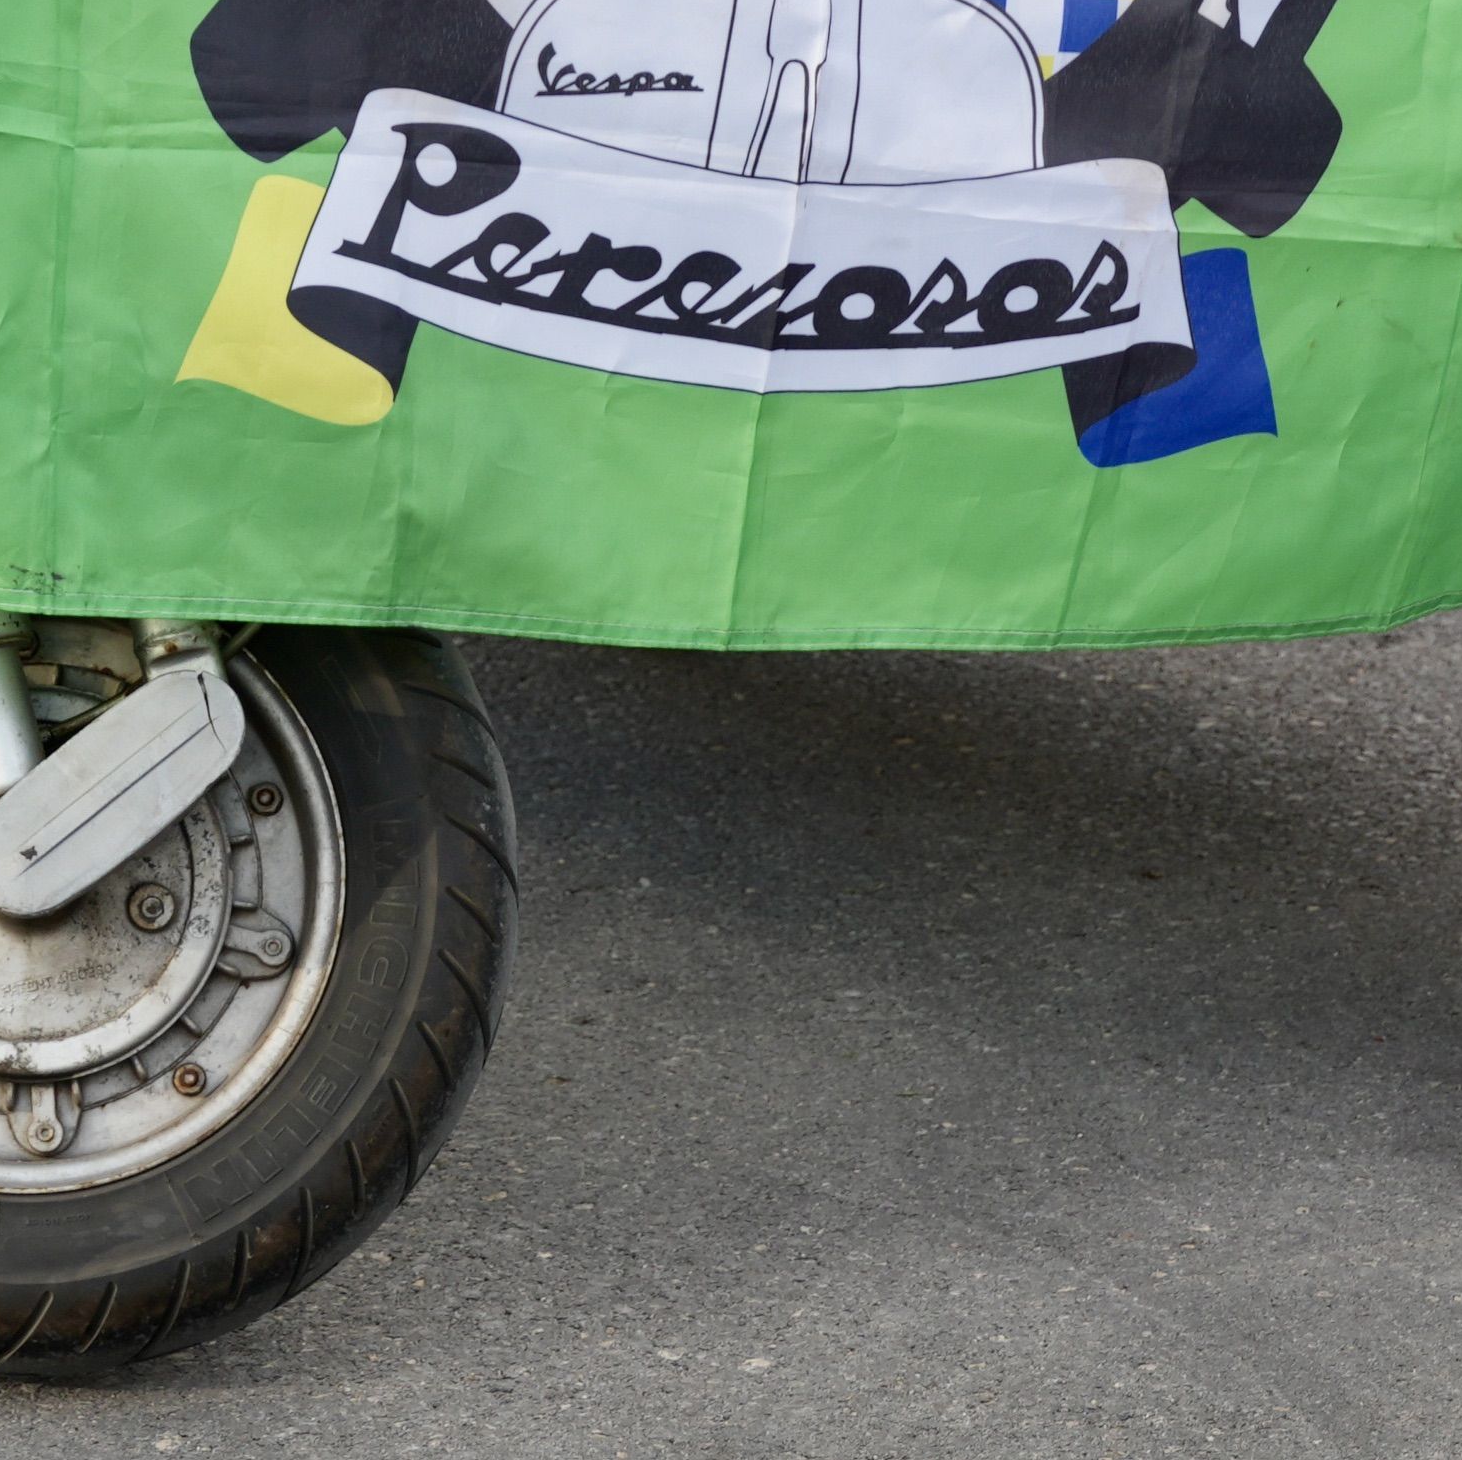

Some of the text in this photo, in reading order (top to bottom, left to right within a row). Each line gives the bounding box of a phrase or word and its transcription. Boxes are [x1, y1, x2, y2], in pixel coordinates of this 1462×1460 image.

[534, 41, 705, 97] Vespa
[333, 120, 1141, 351] Perezosos
[182, 818, 420, 1224] MICHELIN
